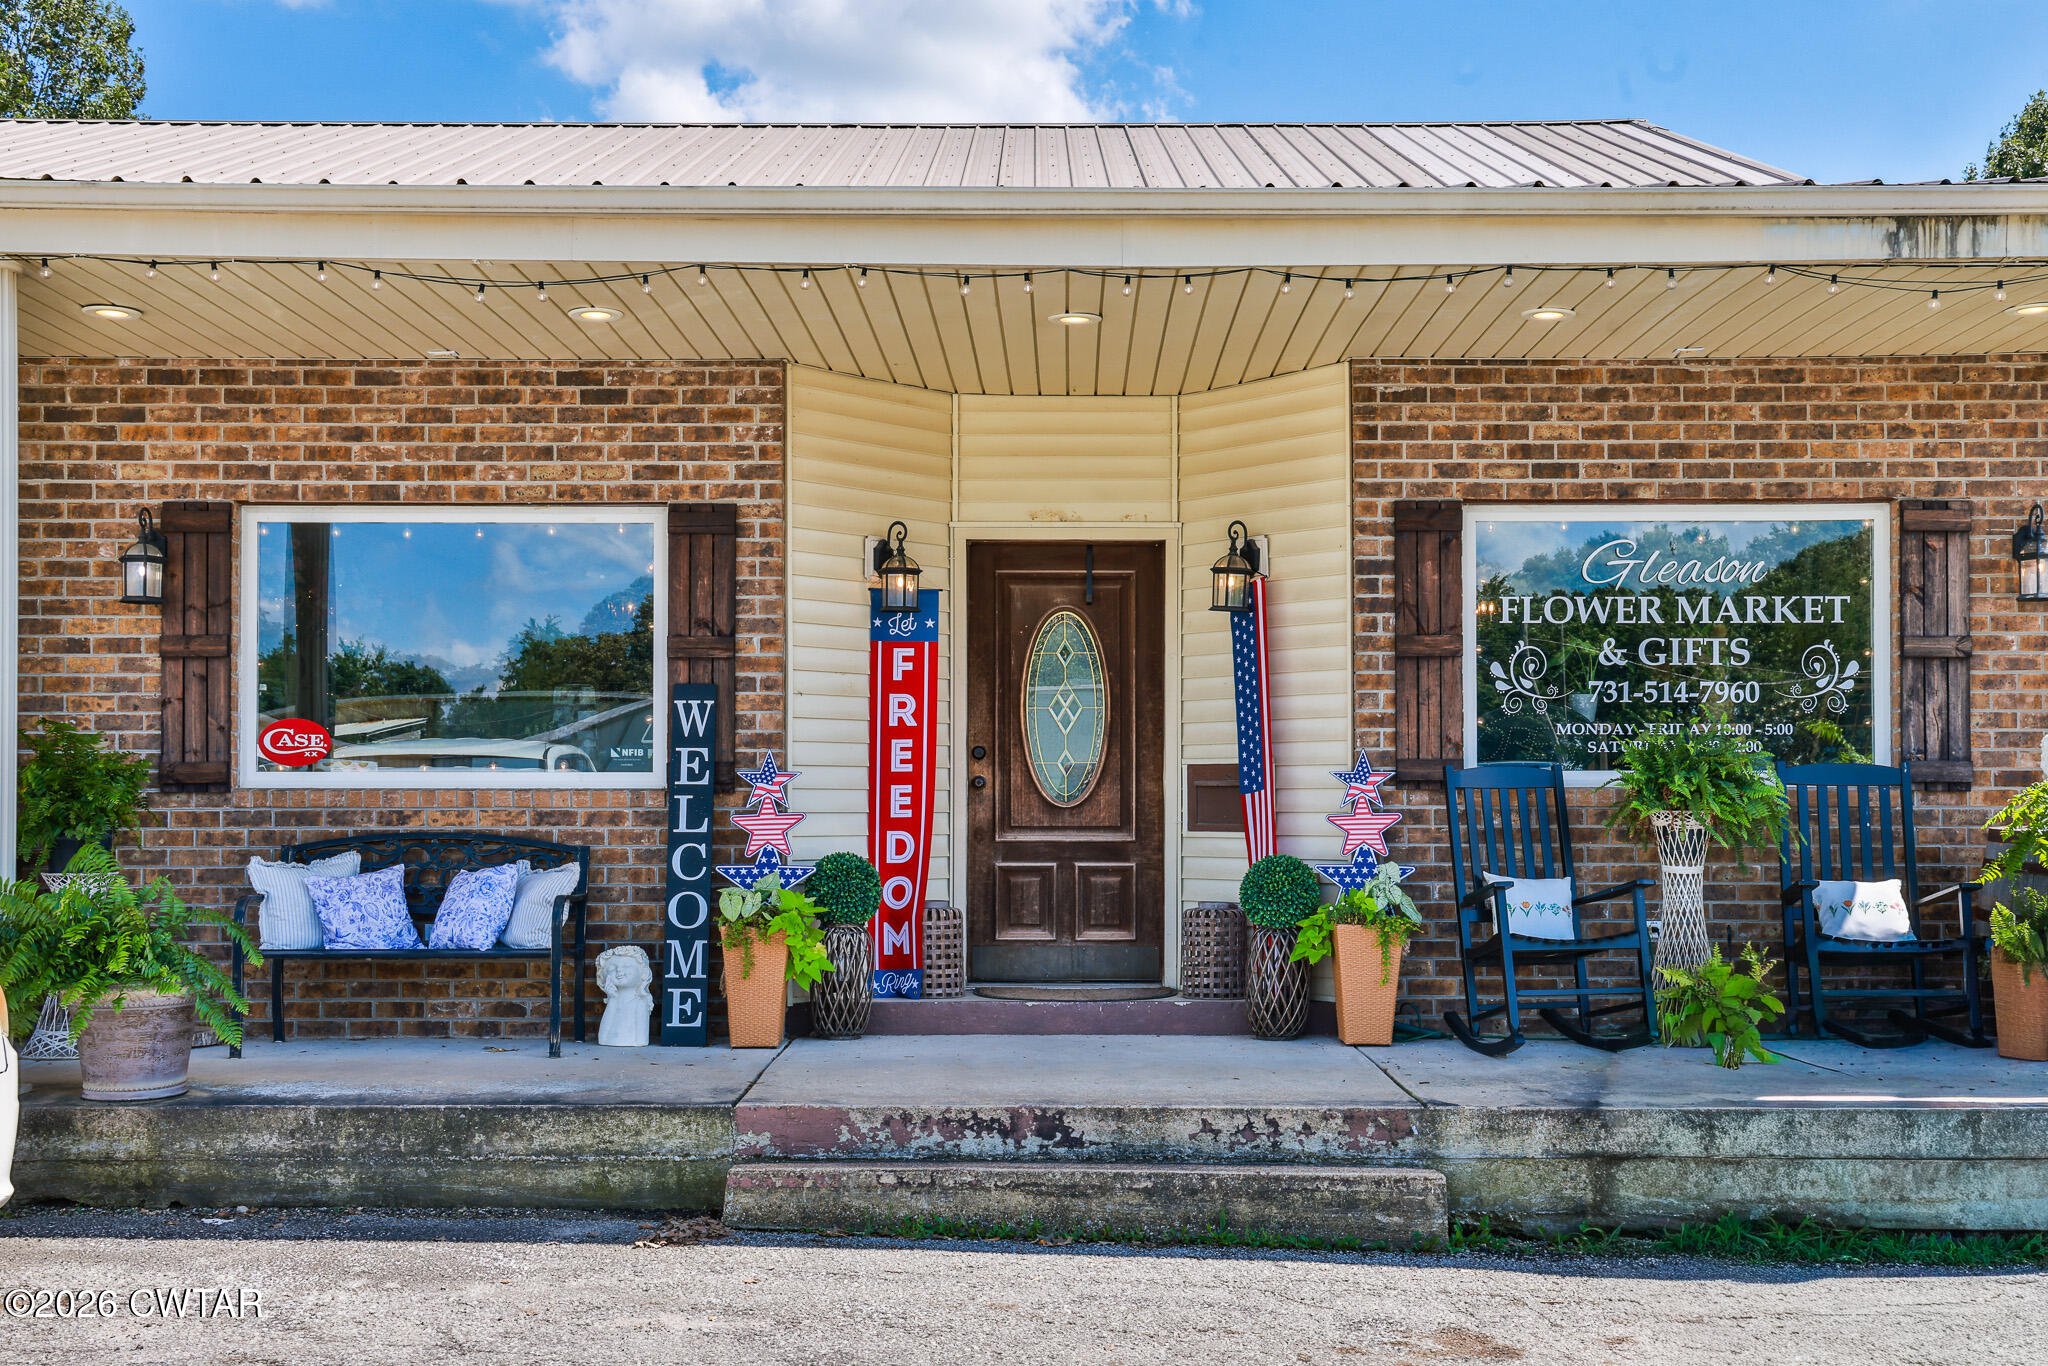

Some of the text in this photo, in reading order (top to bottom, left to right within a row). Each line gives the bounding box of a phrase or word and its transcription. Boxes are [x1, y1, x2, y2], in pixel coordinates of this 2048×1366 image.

[1581, 540, 1768, 591] Gleason
[1499, 596, 1851, 624] FLOWER MARKET
[888, 612, 918, 637] Let
[1598, 638, 1751, 666] & GIFTS
[1588, 681, 1760, 705] 731-514-7960
[1556, 723, 1635, 736] MONDAY
[1765, 723, 1794, 736] 5:00
[882, 647, 919, 956] FREEDOM
[665, 700, 716, 1028] WELCOME
[878, 972, 914, 994] Ring
